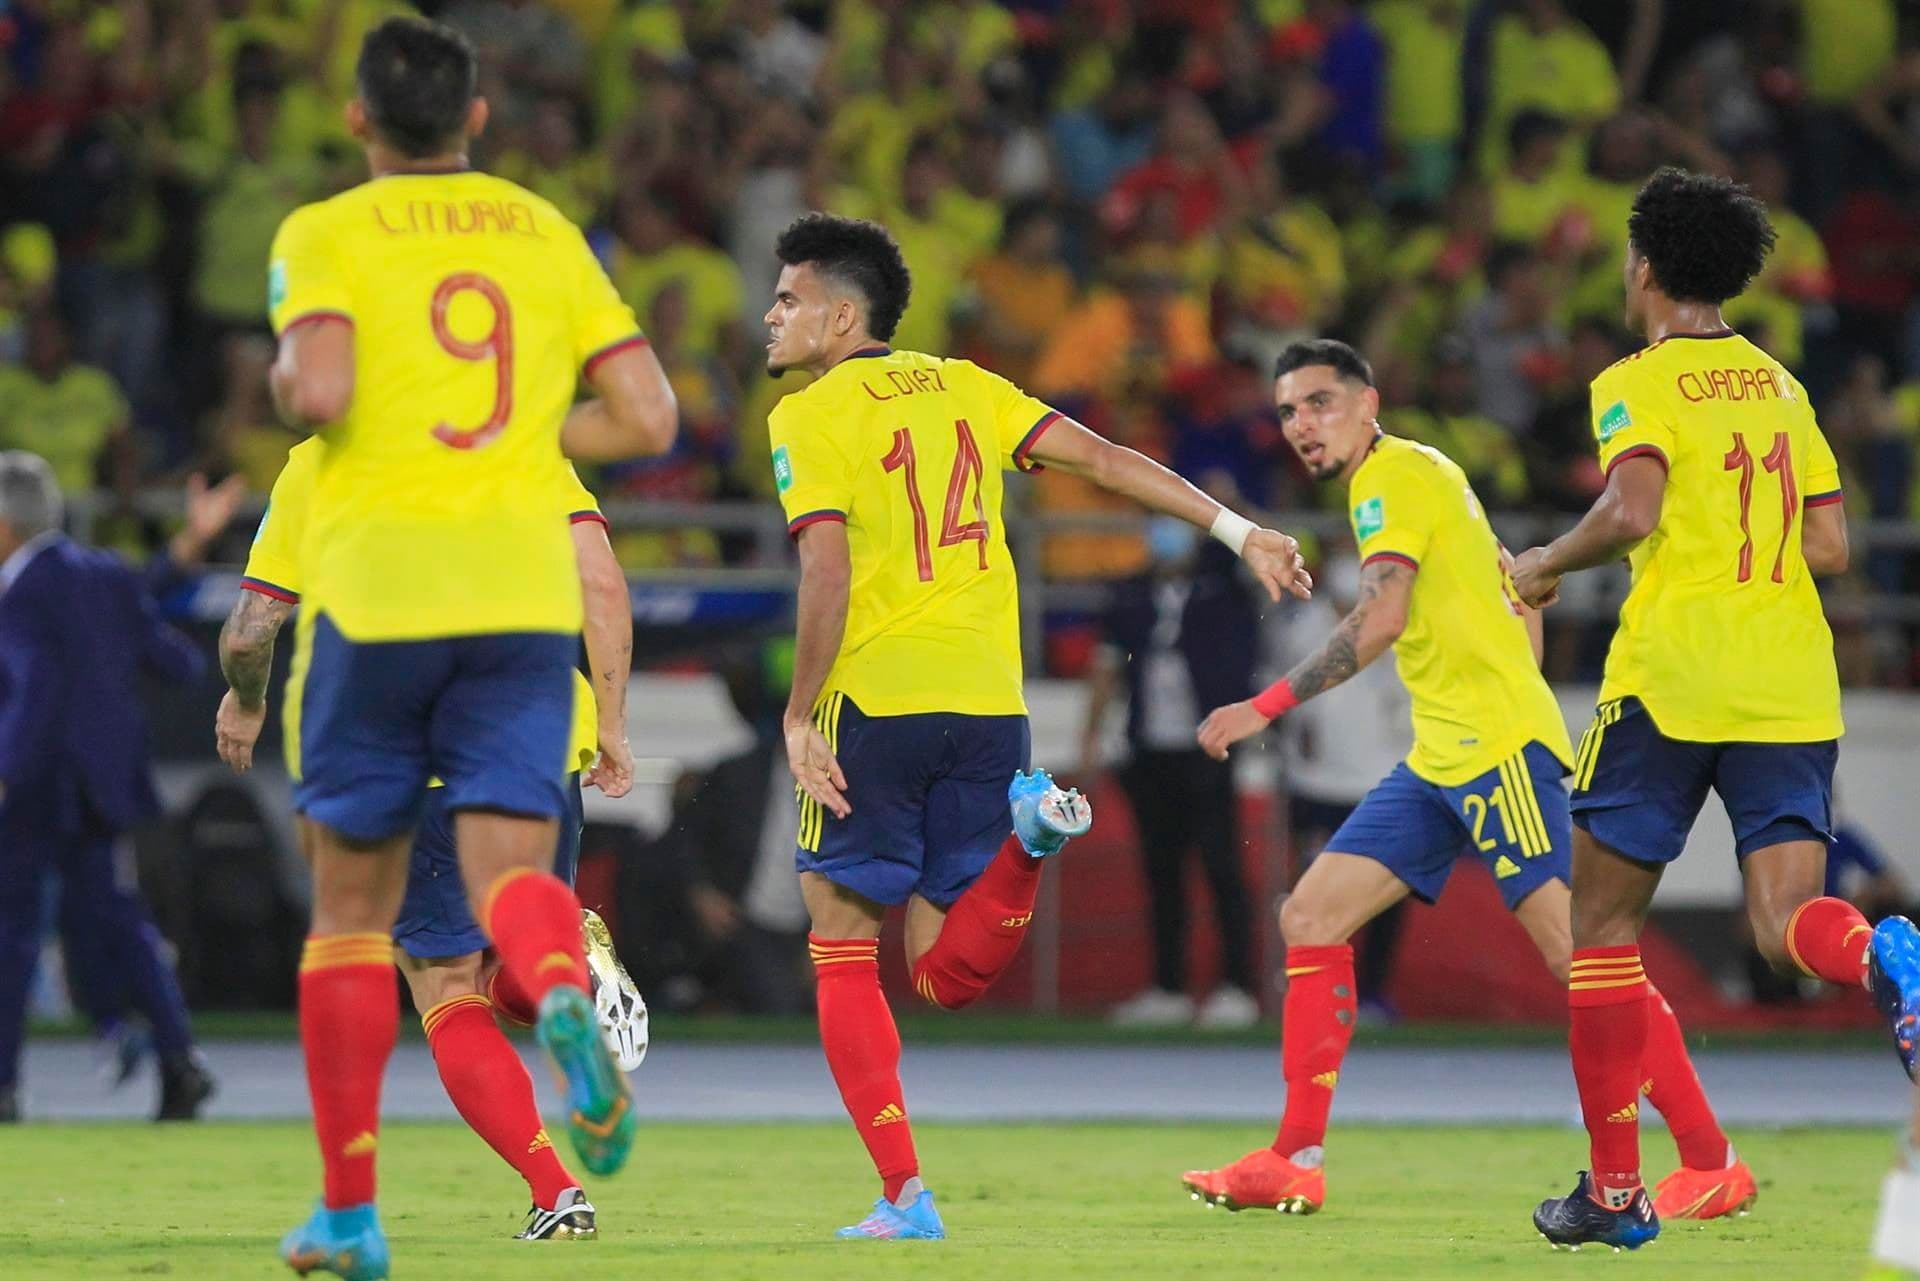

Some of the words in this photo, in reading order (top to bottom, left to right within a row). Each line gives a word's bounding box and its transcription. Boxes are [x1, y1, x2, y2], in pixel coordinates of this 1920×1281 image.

[373, 201, 547, 240] L.MURIEL
[430, 271, 514, 450] 9
[862, 368, 946, 401] L.DIAZ
[880, 419, 990, 583] 14
[1724, 432, 1798, 583] 11
[1463, 786, 1517, 852] 21
